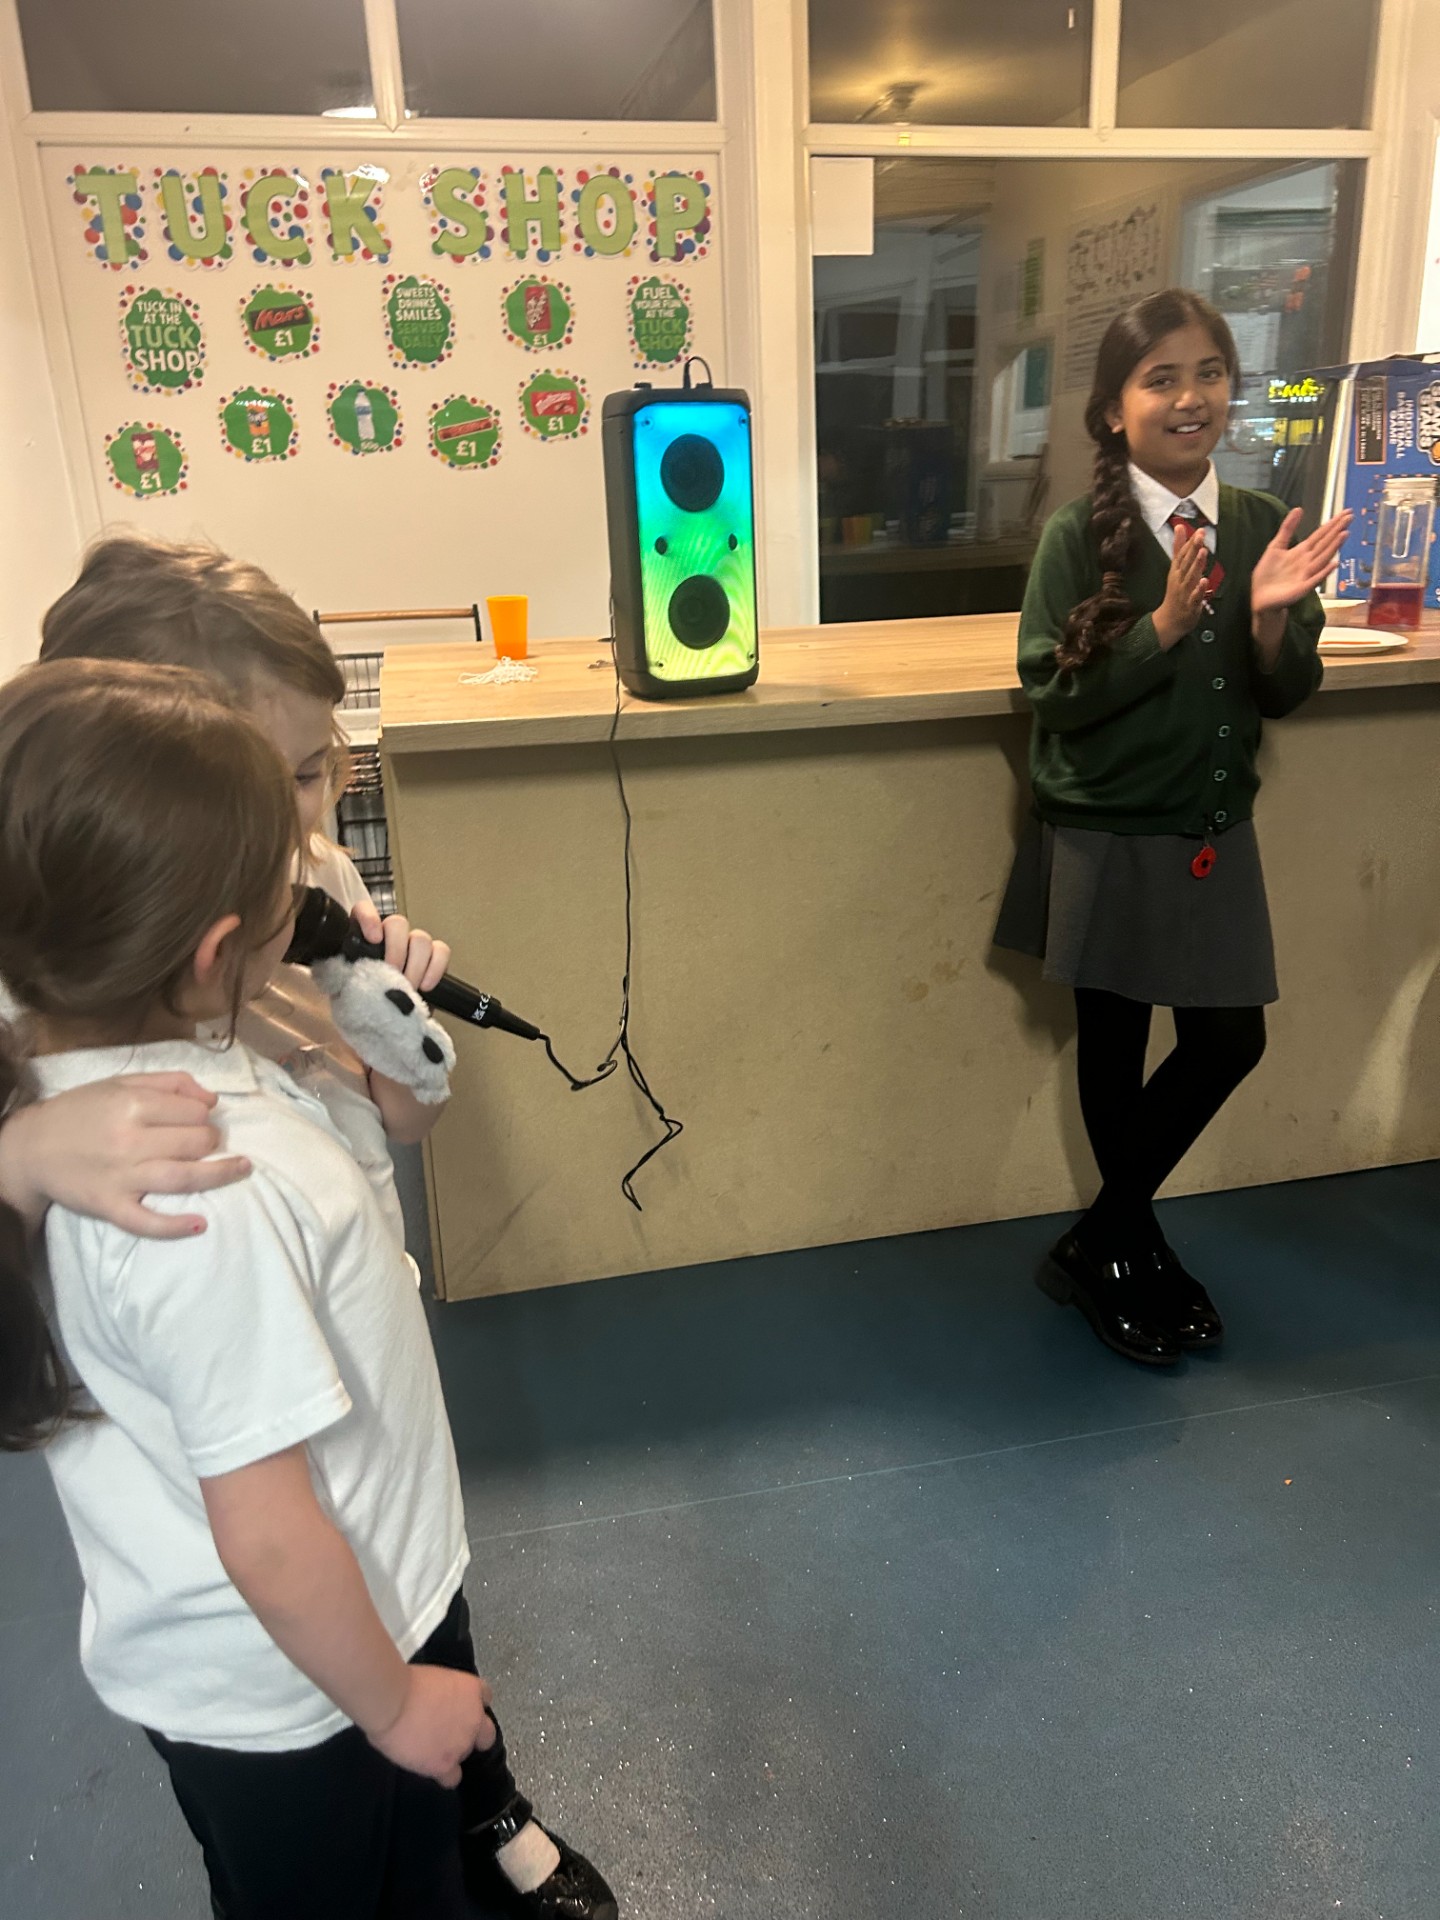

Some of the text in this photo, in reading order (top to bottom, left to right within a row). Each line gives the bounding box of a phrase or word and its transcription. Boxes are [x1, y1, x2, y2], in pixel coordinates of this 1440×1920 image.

[75, 167, 707, 263] TUCK SHOP
[396, 287, 435, 298] SWEETS
[642, 286, 674, 299] FUEL
[136, 301, 181, 313] TUCK IN
[395, 308, 442, 321] SMILES
[143, 313, 182, 325] AT THE
[254, 306, 305, 331] Mars
[636, 318, 683, 335] TUCK
[396, 321, 446, 334] SERVED
[130, 325, 195, 349] TUCK
[274, 329, 294, 347] £1
[401, 335, 440, 348] DAILY
[533, 334, 548, 345] £1
[640, 335, 686, 351] SHOP
[134, 348, 200, 372] SHOP
[547, 416, 564, 431] £1
[1389, 409, 1398, 445] GAME
[1396, 391, 1406, 459] BASKETBALL
[1404, 399, 1415, 447] INDOOR
[1420, 394, 1433, 447] STARS
[252, 437, 272, 454] £1
[456, 440, 477, 457] £1
[140, 471, 162, 489] £1
